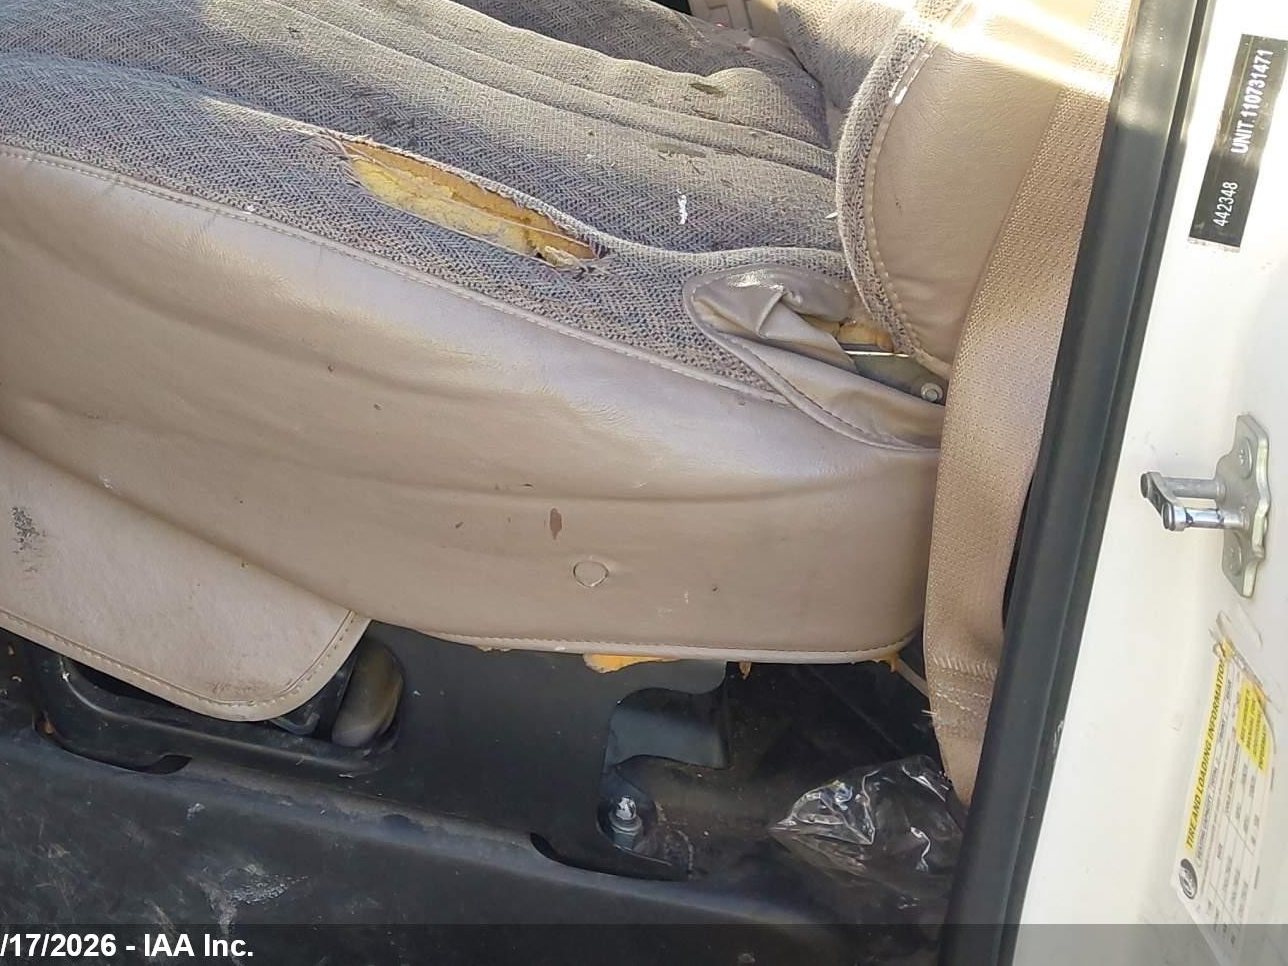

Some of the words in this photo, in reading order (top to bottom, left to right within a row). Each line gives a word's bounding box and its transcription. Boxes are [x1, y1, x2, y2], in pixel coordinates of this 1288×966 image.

[1212, 181, 1238, 227] 442348
[1196, 740, 1212, 795] LOADING
[1192, 794, 1202, 822] AND
[1186, 820, 1197, 849] TIRE
